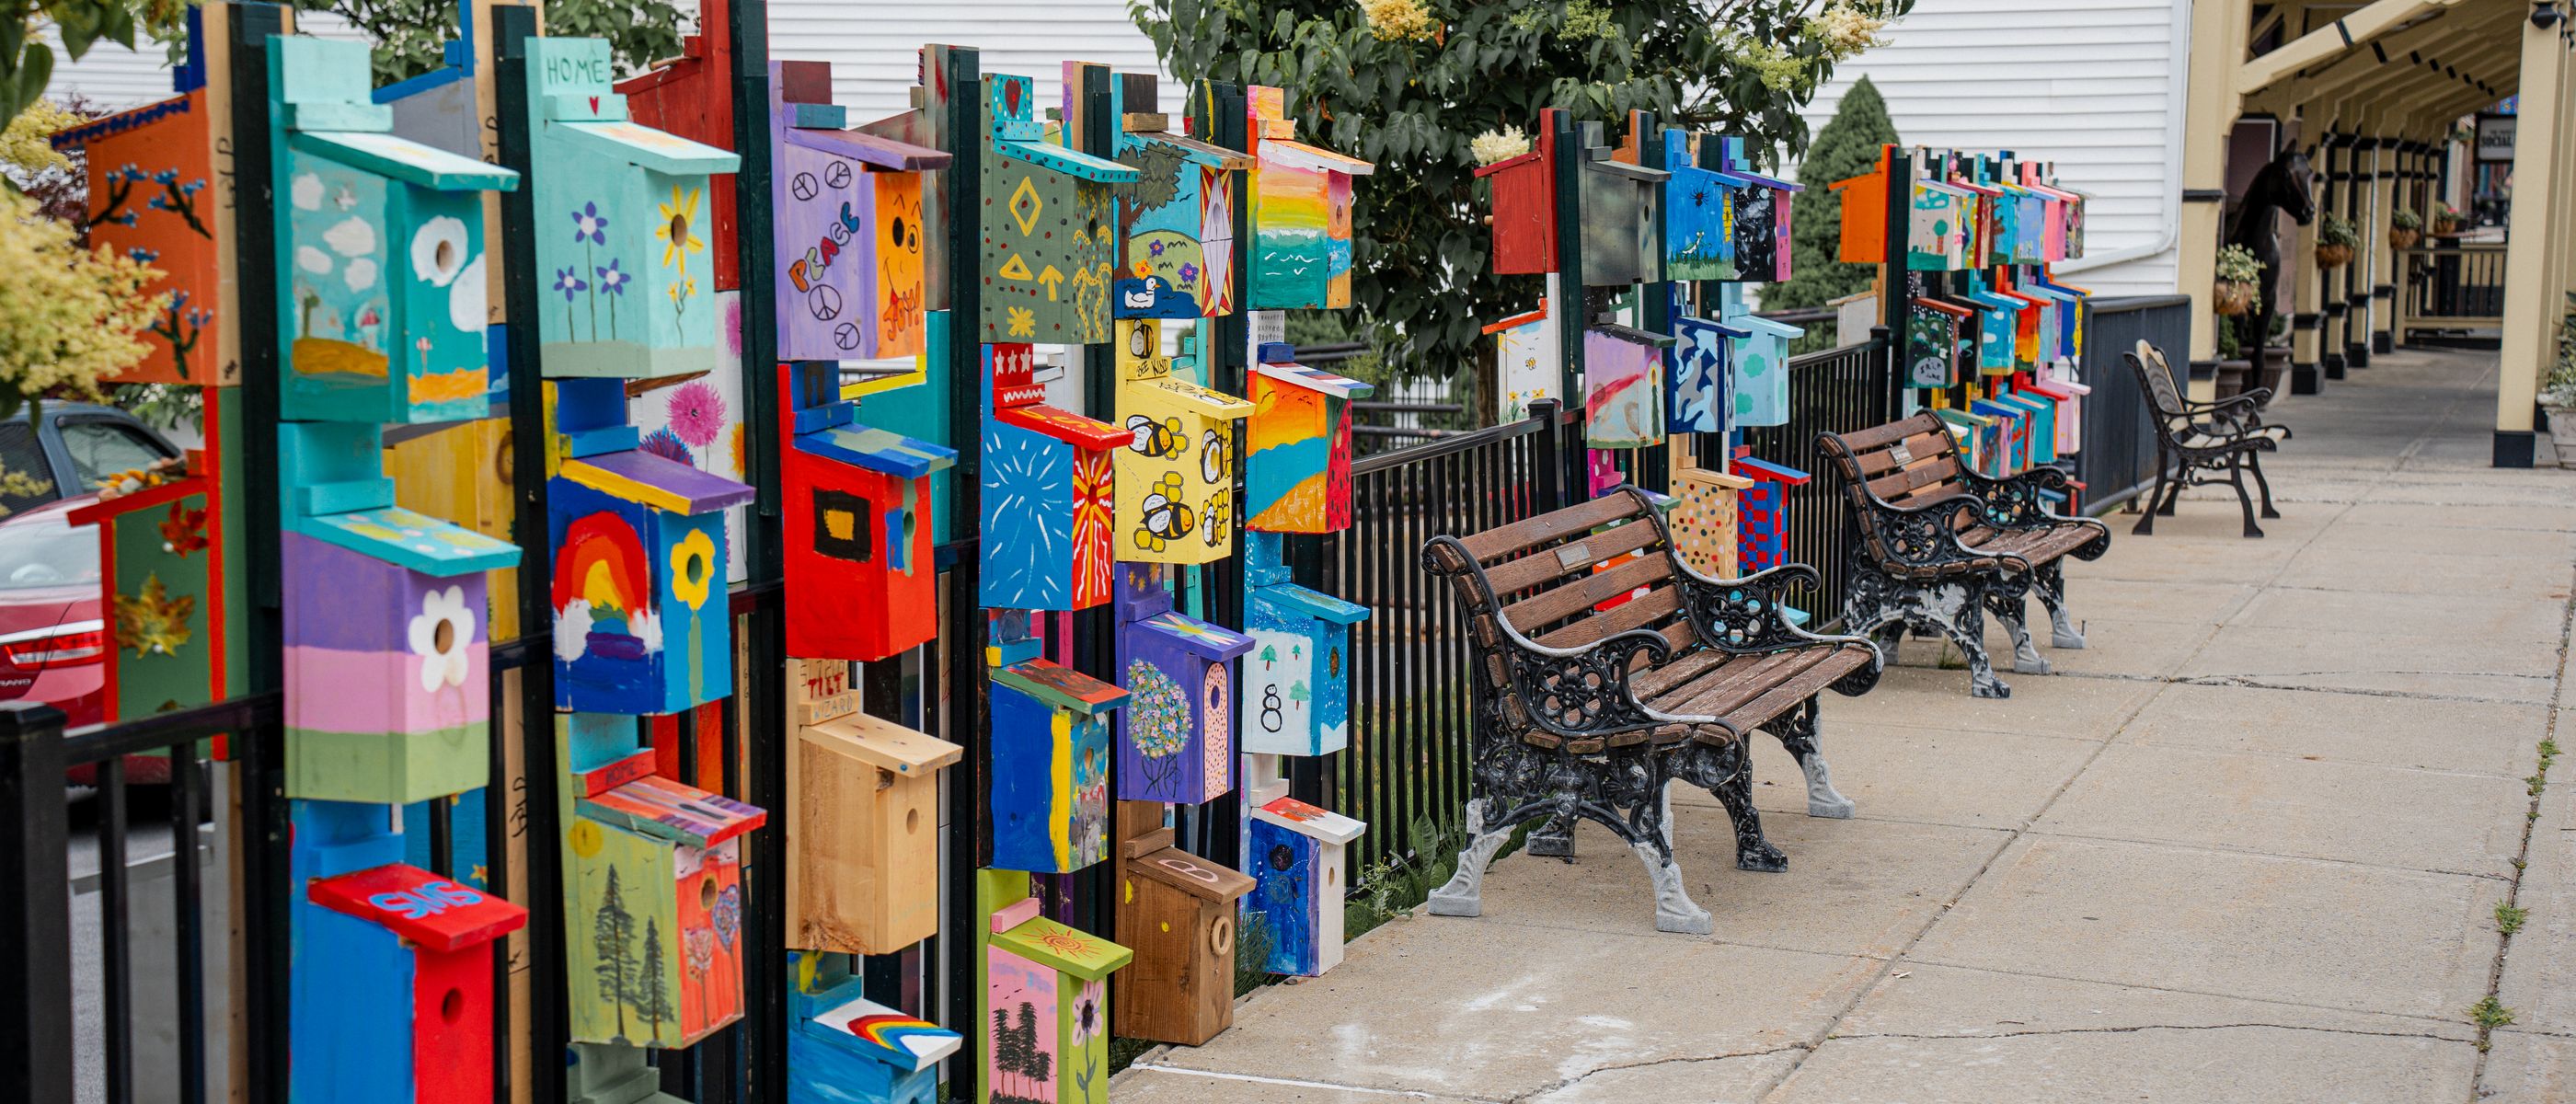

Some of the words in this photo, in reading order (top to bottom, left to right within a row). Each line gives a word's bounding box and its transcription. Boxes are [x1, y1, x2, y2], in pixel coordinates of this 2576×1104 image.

[546, 56, 604, 85] HOME
[788, 201, 860, 293] PEACE
[1151, 359, 1168, 377] KIND
[808, 672, 845, 699] TILT
[368, 880, 483, 919] SMS
